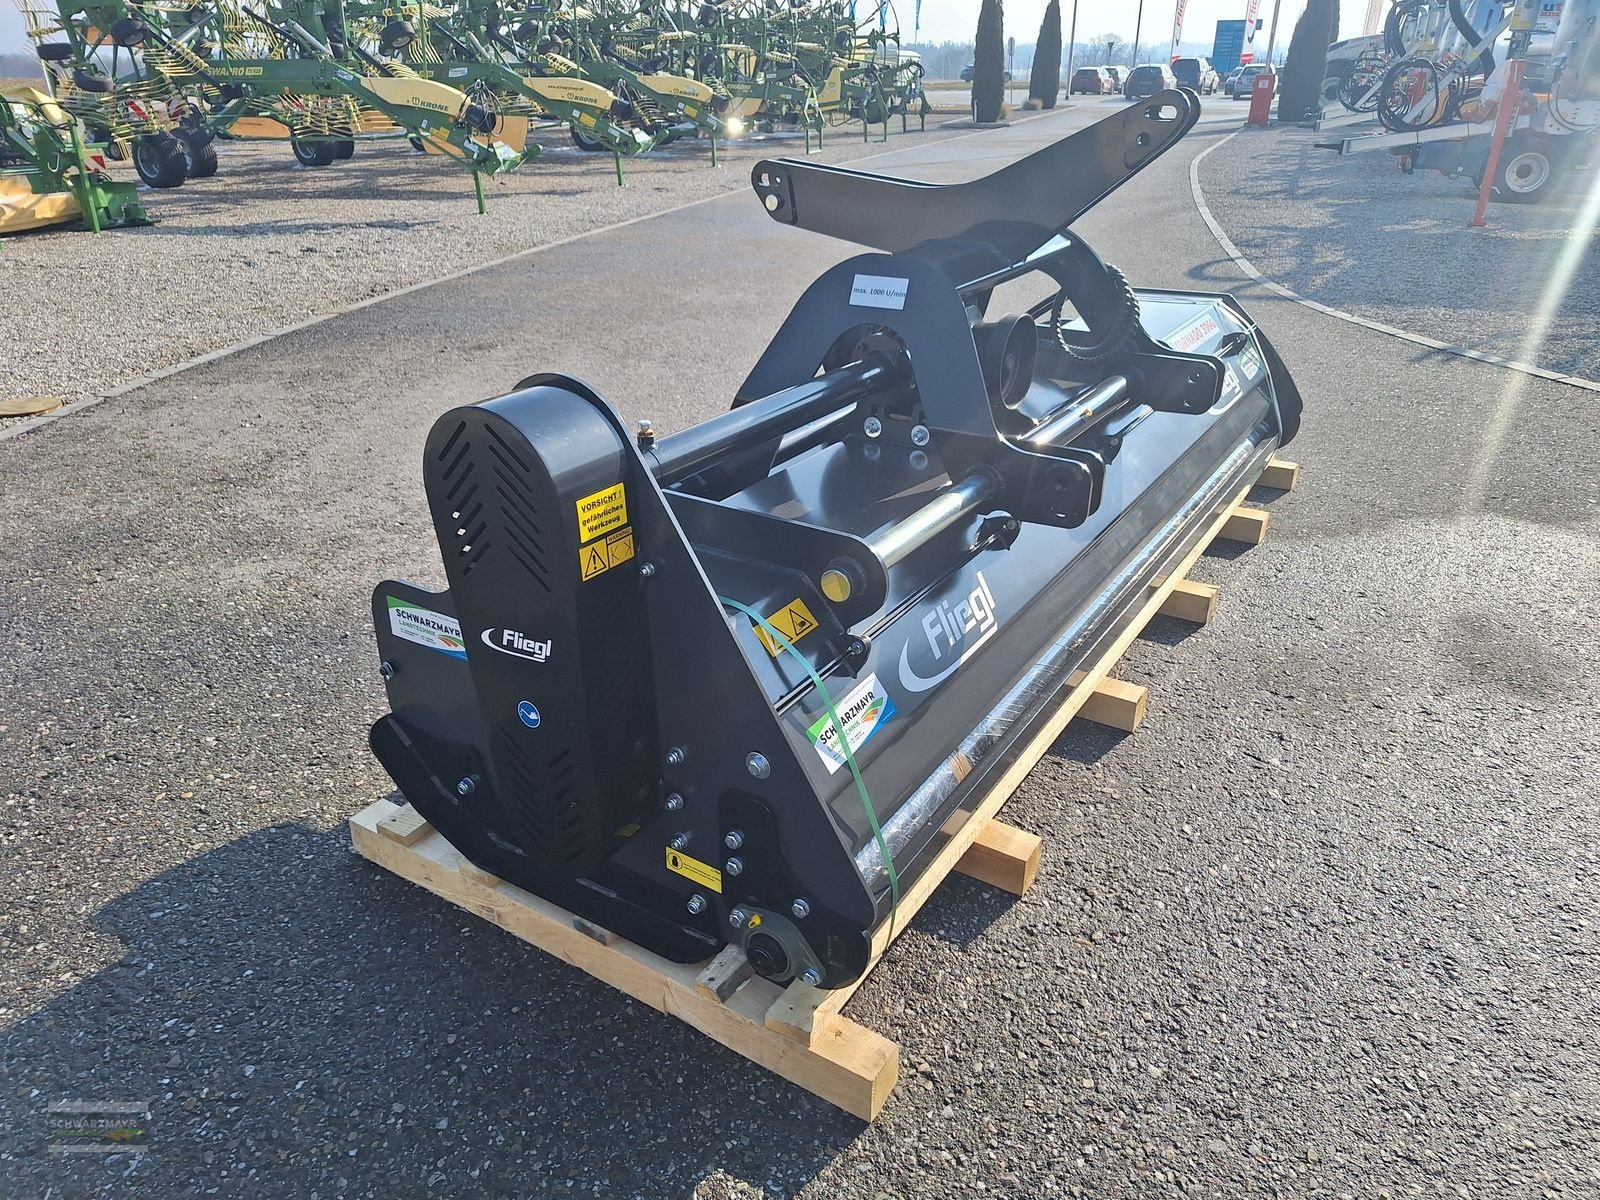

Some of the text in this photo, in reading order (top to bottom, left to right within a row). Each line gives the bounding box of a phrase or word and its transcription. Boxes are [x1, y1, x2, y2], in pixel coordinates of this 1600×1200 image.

[207, 67, 244, 76] SWARO
[420, 100, 449, 112] KRONE
[574, 95, 599, 104] KRONE
[870, 288, 885, 296] 1000
[581, 492, 617, 512] VORSICHT
[582, 503, 624, 527] gefährliches
[587, 515, 621, 533] Werkzeug
[395, 608, 461, 638] SCHWARZMAYR
[921, 570, 996, 661] Fliegl
[399, 619, 436, 636] LANDTECHNIK
[502, 628, 552, 660] Fliegl
[819, 691, 876, 745] SCHARZMAYR
